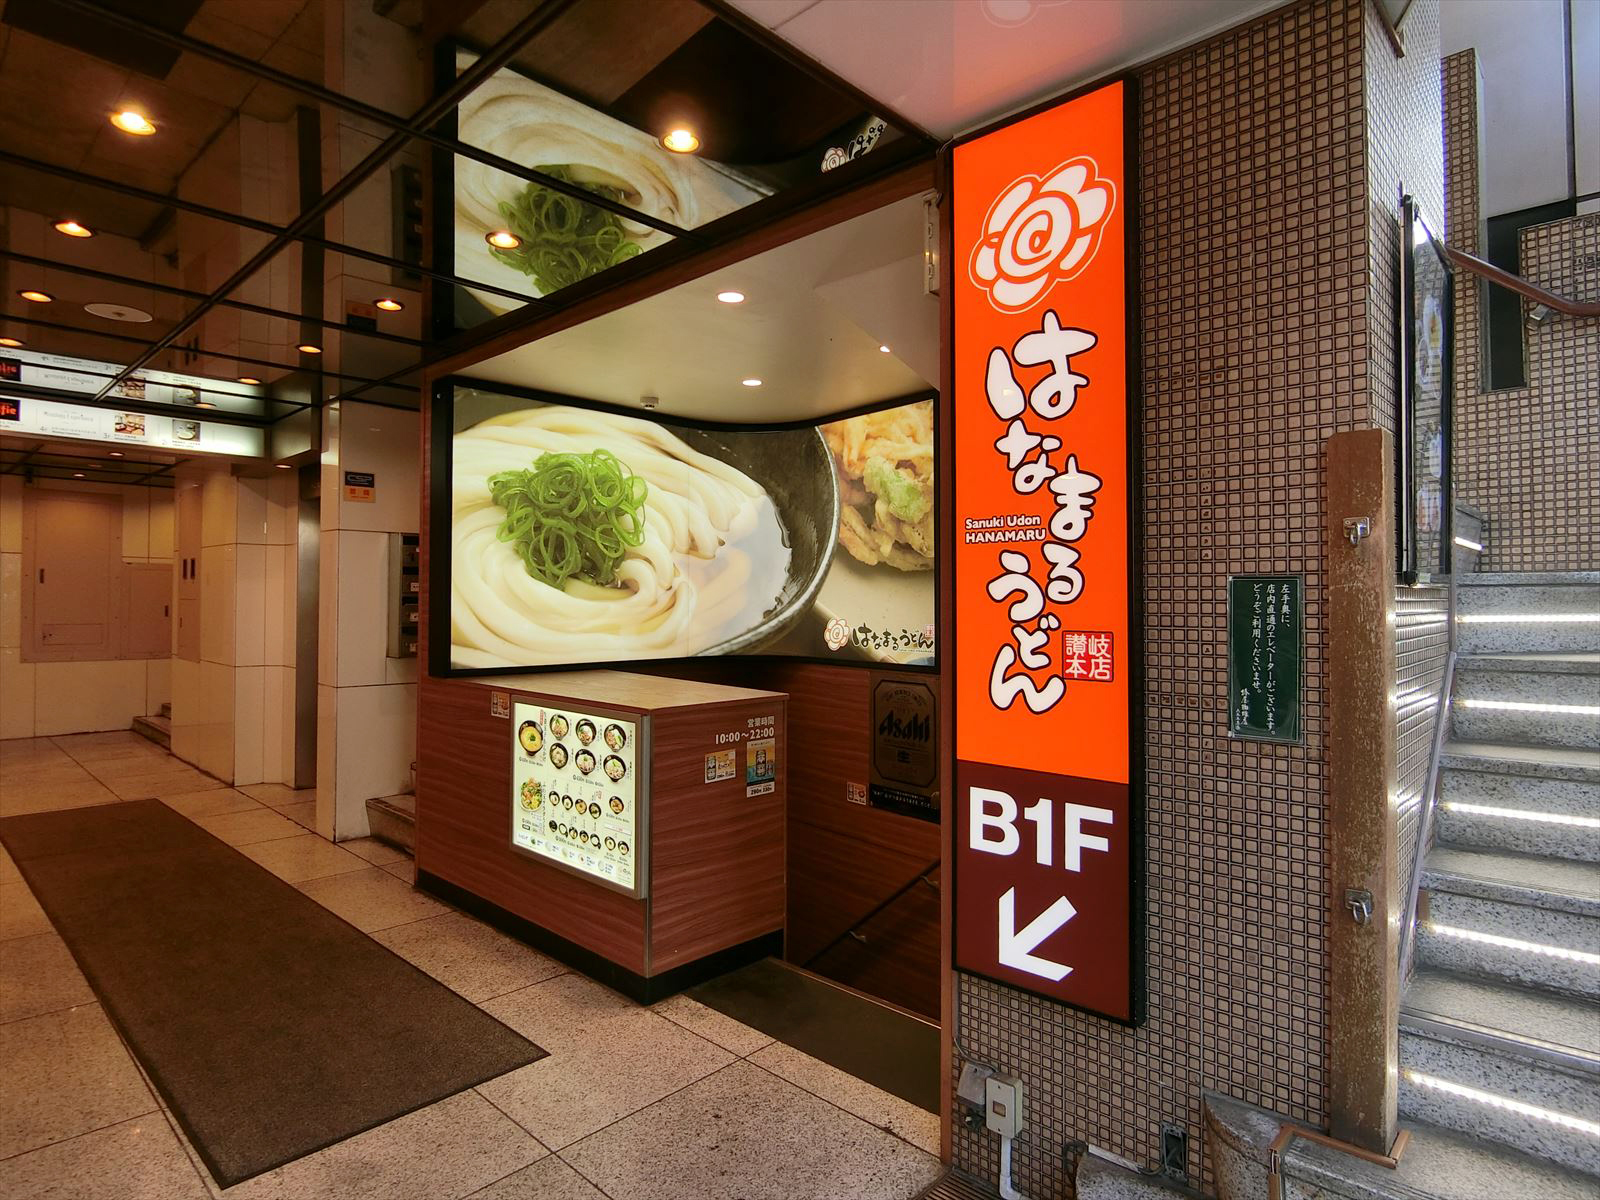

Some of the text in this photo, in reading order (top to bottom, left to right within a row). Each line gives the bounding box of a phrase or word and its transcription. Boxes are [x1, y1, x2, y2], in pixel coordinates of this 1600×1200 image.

[965, 514, 1041, 530] Sanuki Udon
[984, 309, 1103, 715] はなまるうどん
[965, 528, 1047, 543] HANAMARU
[852, 621, 935, 651] はなまるうどん
[879, 709, 931, 743] Asahi
[970, 786, 1113, 872] B1F
